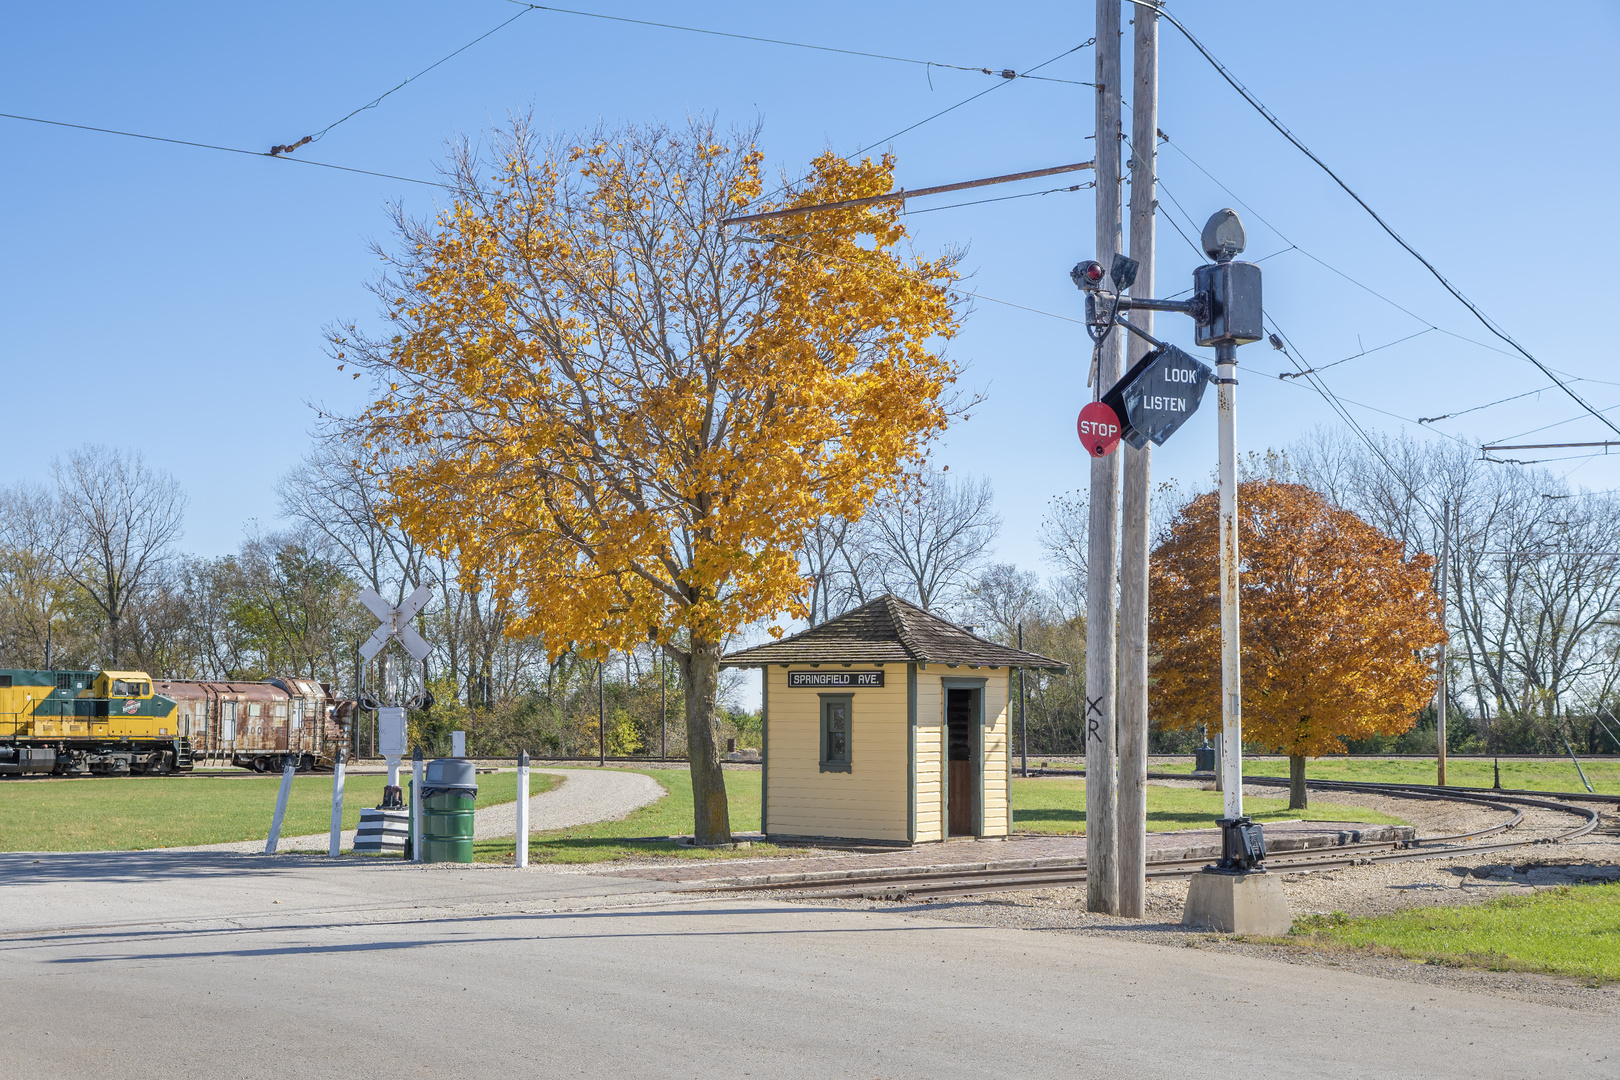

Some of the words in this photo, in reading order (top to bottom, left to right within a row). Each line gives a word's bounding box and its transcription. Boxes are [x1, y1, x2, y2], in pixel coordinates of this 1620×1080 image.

[1165, 367, 1197, 384] LOOK
[1143, 395, 1186, 412] LISTEN
[1080, 420, 1118, 438] STOP
[793, 674, 850, 684] SPRINGFIELD
[858, 674, 880, 684] AVE.
[1086, 696, 1103, 717] X
[1087, 718, 1103, 744] R
